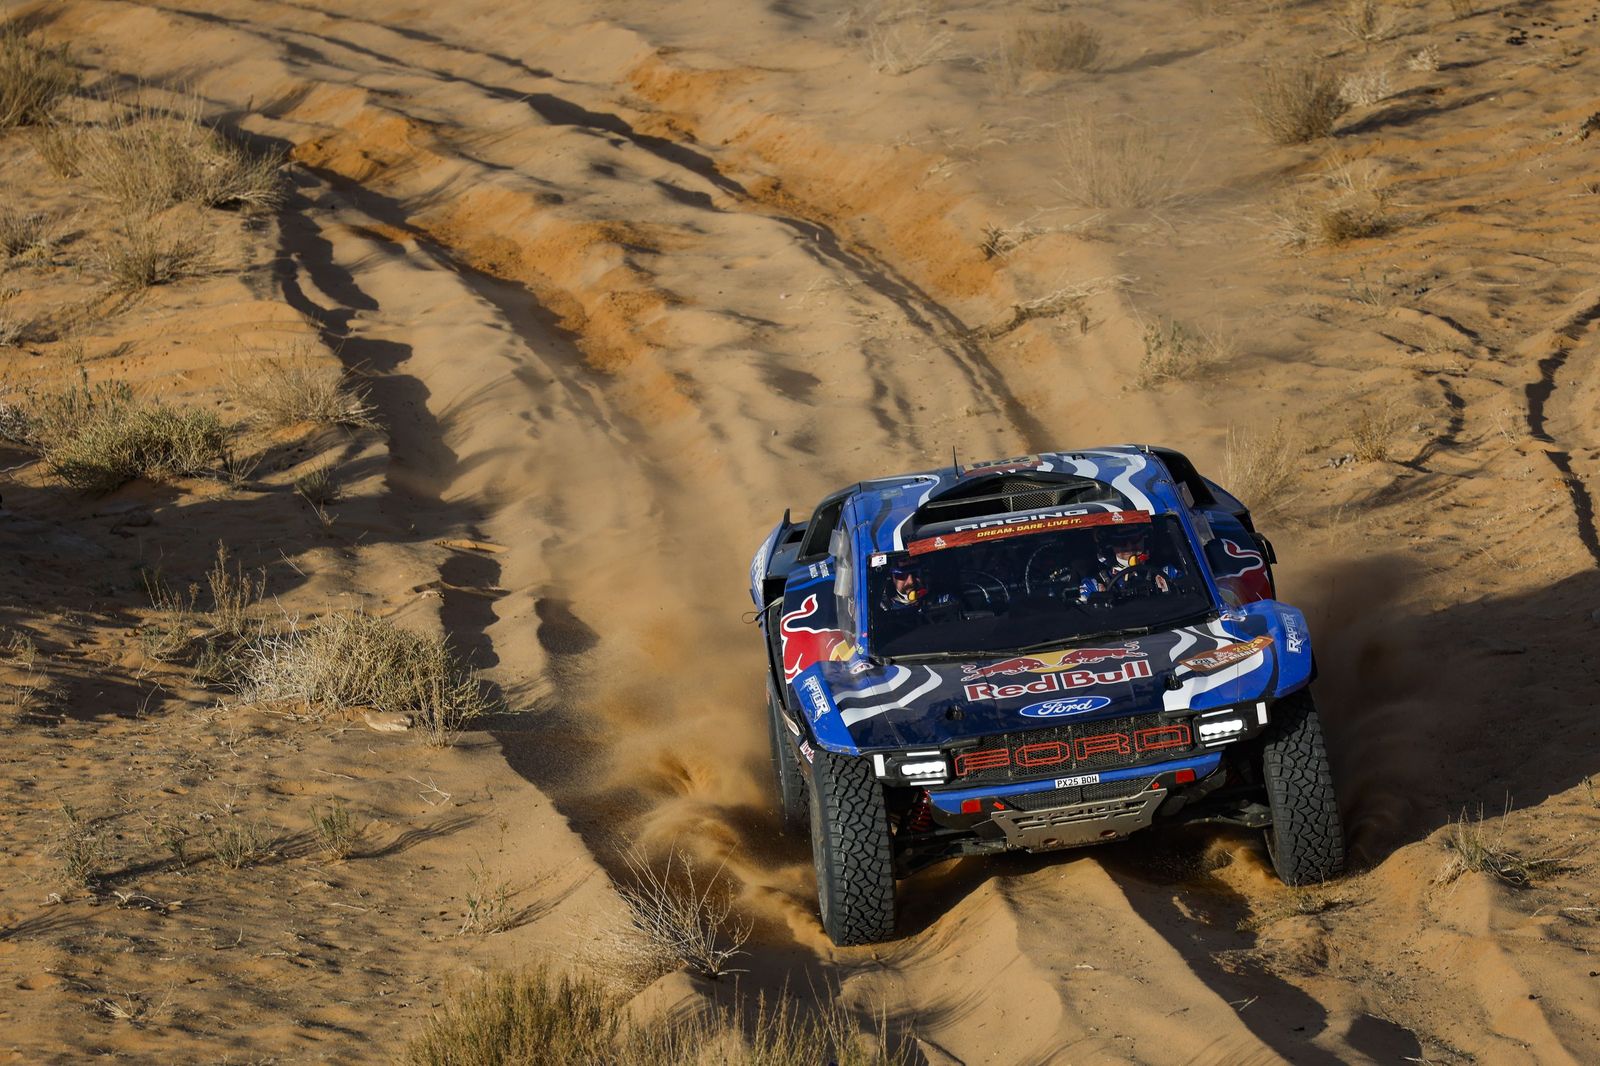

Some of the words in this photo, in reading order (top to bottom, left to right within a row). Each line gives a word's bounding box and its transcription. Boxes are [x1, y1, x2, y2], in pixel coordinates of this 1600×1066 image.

[976, 528, 1015, 538] DREAM.
[1016, 523, 1046, 533] DARE.
[1047, 519, 1068, 527] LIVE
[1281, 613, 1306, 654] RAPTOR
[964, 673, 1059, 701] Red
[1060, 659, 1152, 690] Bull
[1038, 699, 1092, 716] Ford
[954, 724, 1191, 776] FORD
[1057, 777, 1079, 788] PX25
